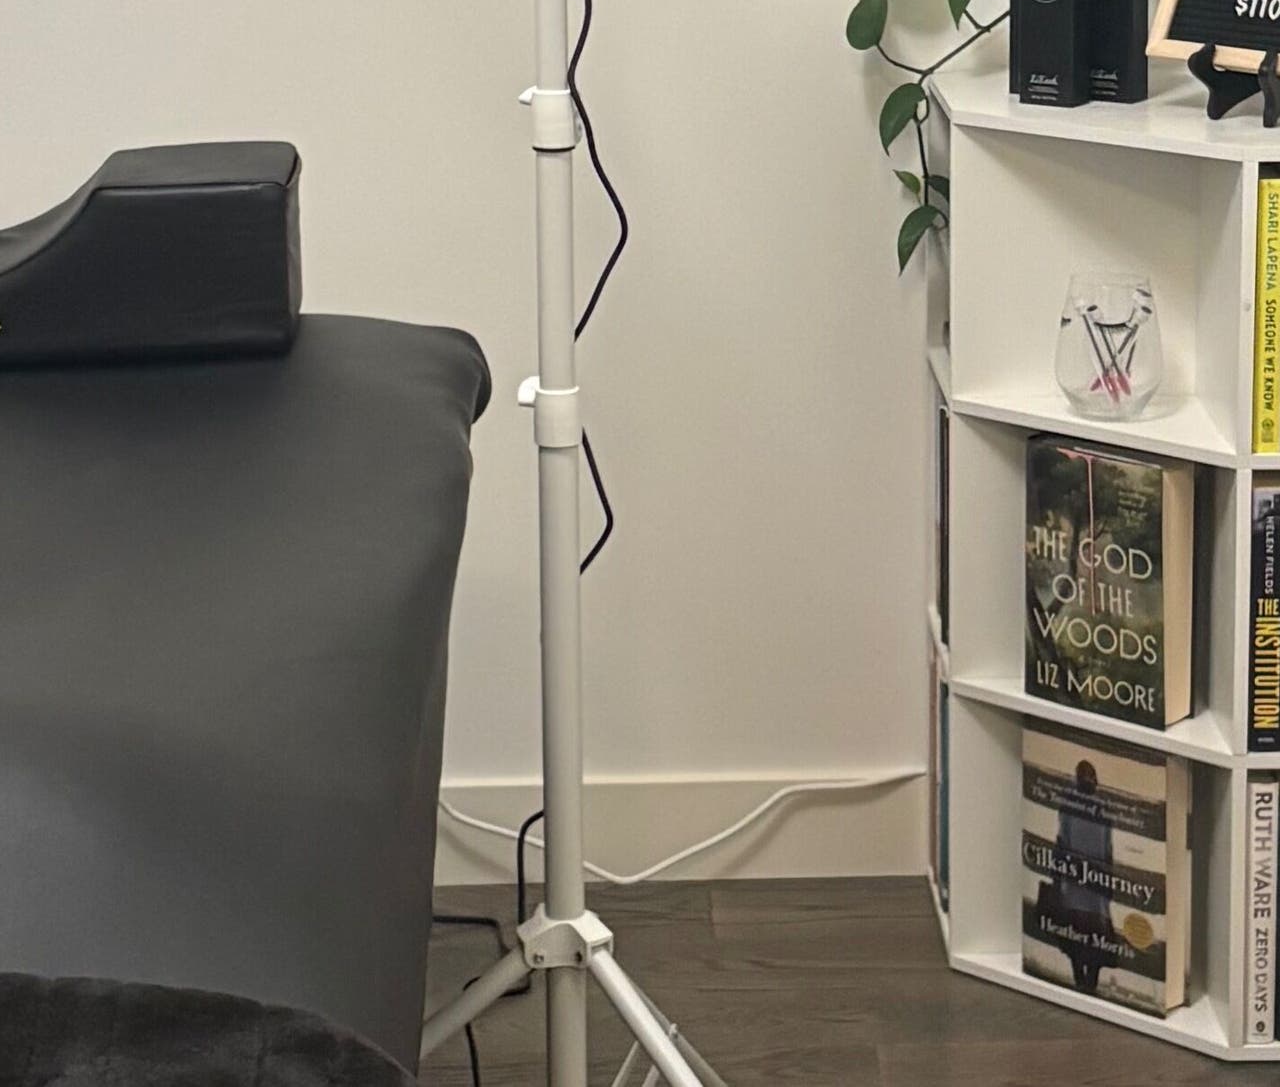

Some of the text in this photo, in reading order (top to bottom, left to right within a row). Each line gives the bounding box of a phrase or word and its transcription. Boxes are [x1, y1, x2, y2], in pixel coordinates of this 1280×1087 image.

[1266, 192, 1279, 291] SHARI LAPENA
[1263, 299, 1277, 411] SOMEONE WE KNOW
[1033, 525, 1153, 580] THE GOD
[1264, 515, 1275, 594] HELEN FIELDS
[1052, 574, 1134, 618] OF THE
[1257, 598, 1280, 616] THE
[1033, 607, 1158, 665] WOODS
[1036, 660, 1155, 713] LIZ MOORE
[1253, 617, 1280, 729] INSTITUTION
[1023, 841, 1155, 905] Cilka's Journey
[1254, 792, 1273, 919] RUTH WARE
[1040, 914, 1090, 946] Heather
[1091, 932, 1136, 960] Morris
[1254, 928, 1268, 1012] ZERO DAYS
